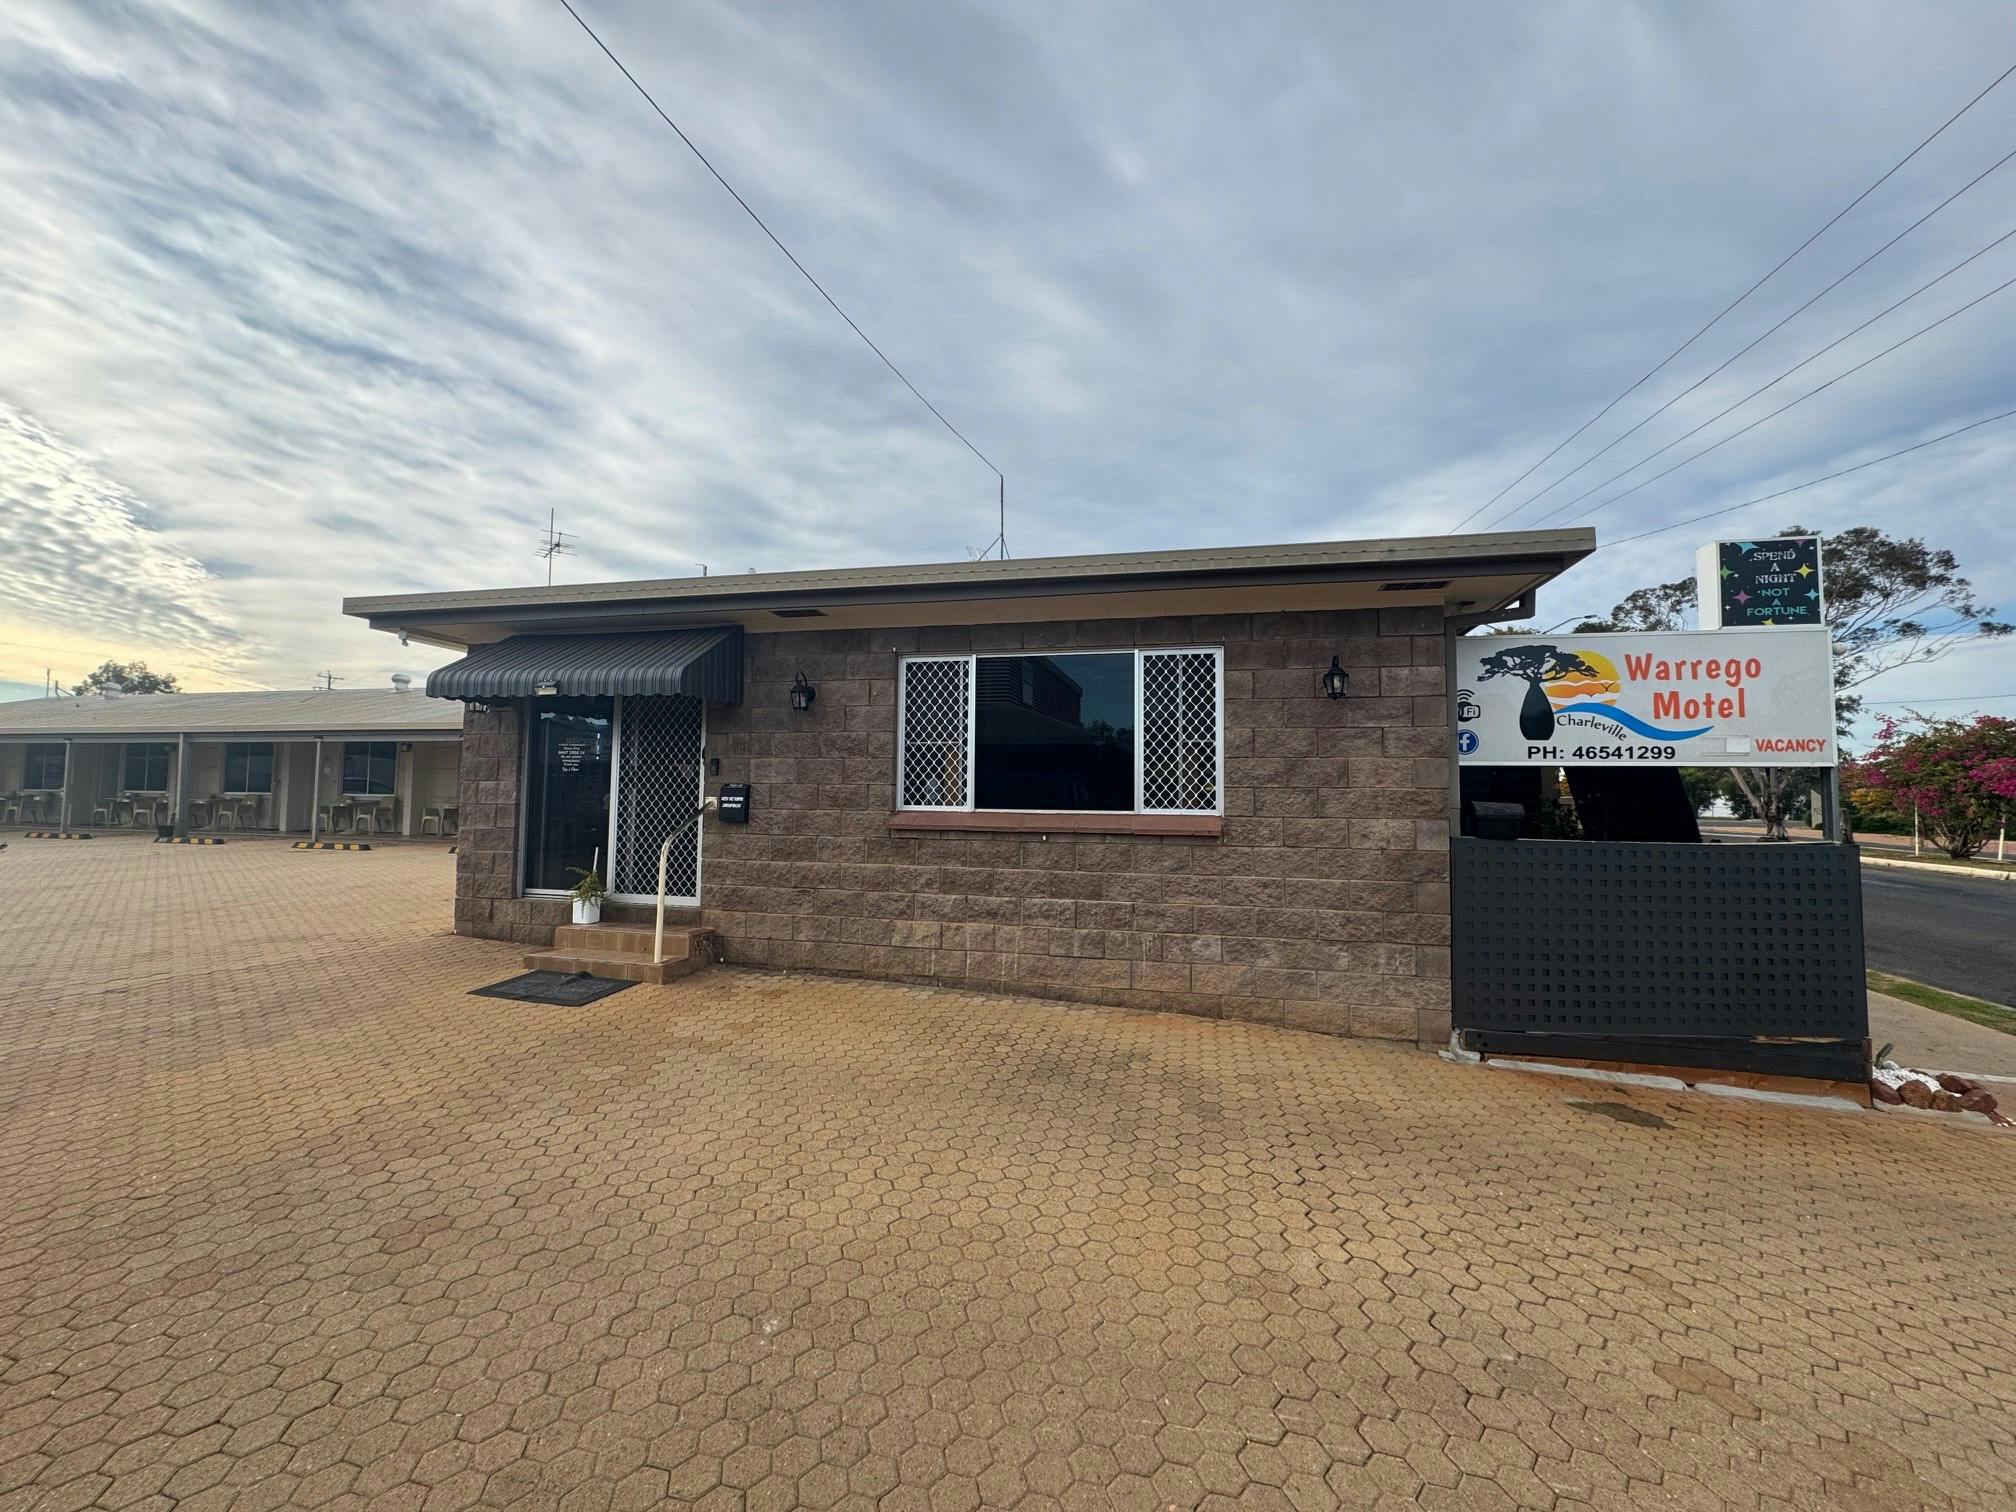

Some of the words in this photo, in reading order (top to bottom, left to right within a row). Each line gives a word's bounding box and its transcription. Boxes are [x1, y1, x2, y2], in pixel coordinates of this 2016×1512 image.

[1753, 550, 1796, 561] SPEND
[1770, 562, 1780, 572] A
[1755, 574, 1795, 584] NIGHT
[1761, 588, 1790, 597] NOT
[1771, 598, 1781, 606] A
[1746, 606, 1807, 616] FORTUNE
[1624, 653, 1762, 688] Warrego
[1653, 688, 1746, 720] Motel
[1556, 714, 1627, 741] Charleville
[1755, 739, 1826, 752] VACANCY
[1527, 746, 1564, 759] PH:
[1572, 746, 1676, 759] 46541299
